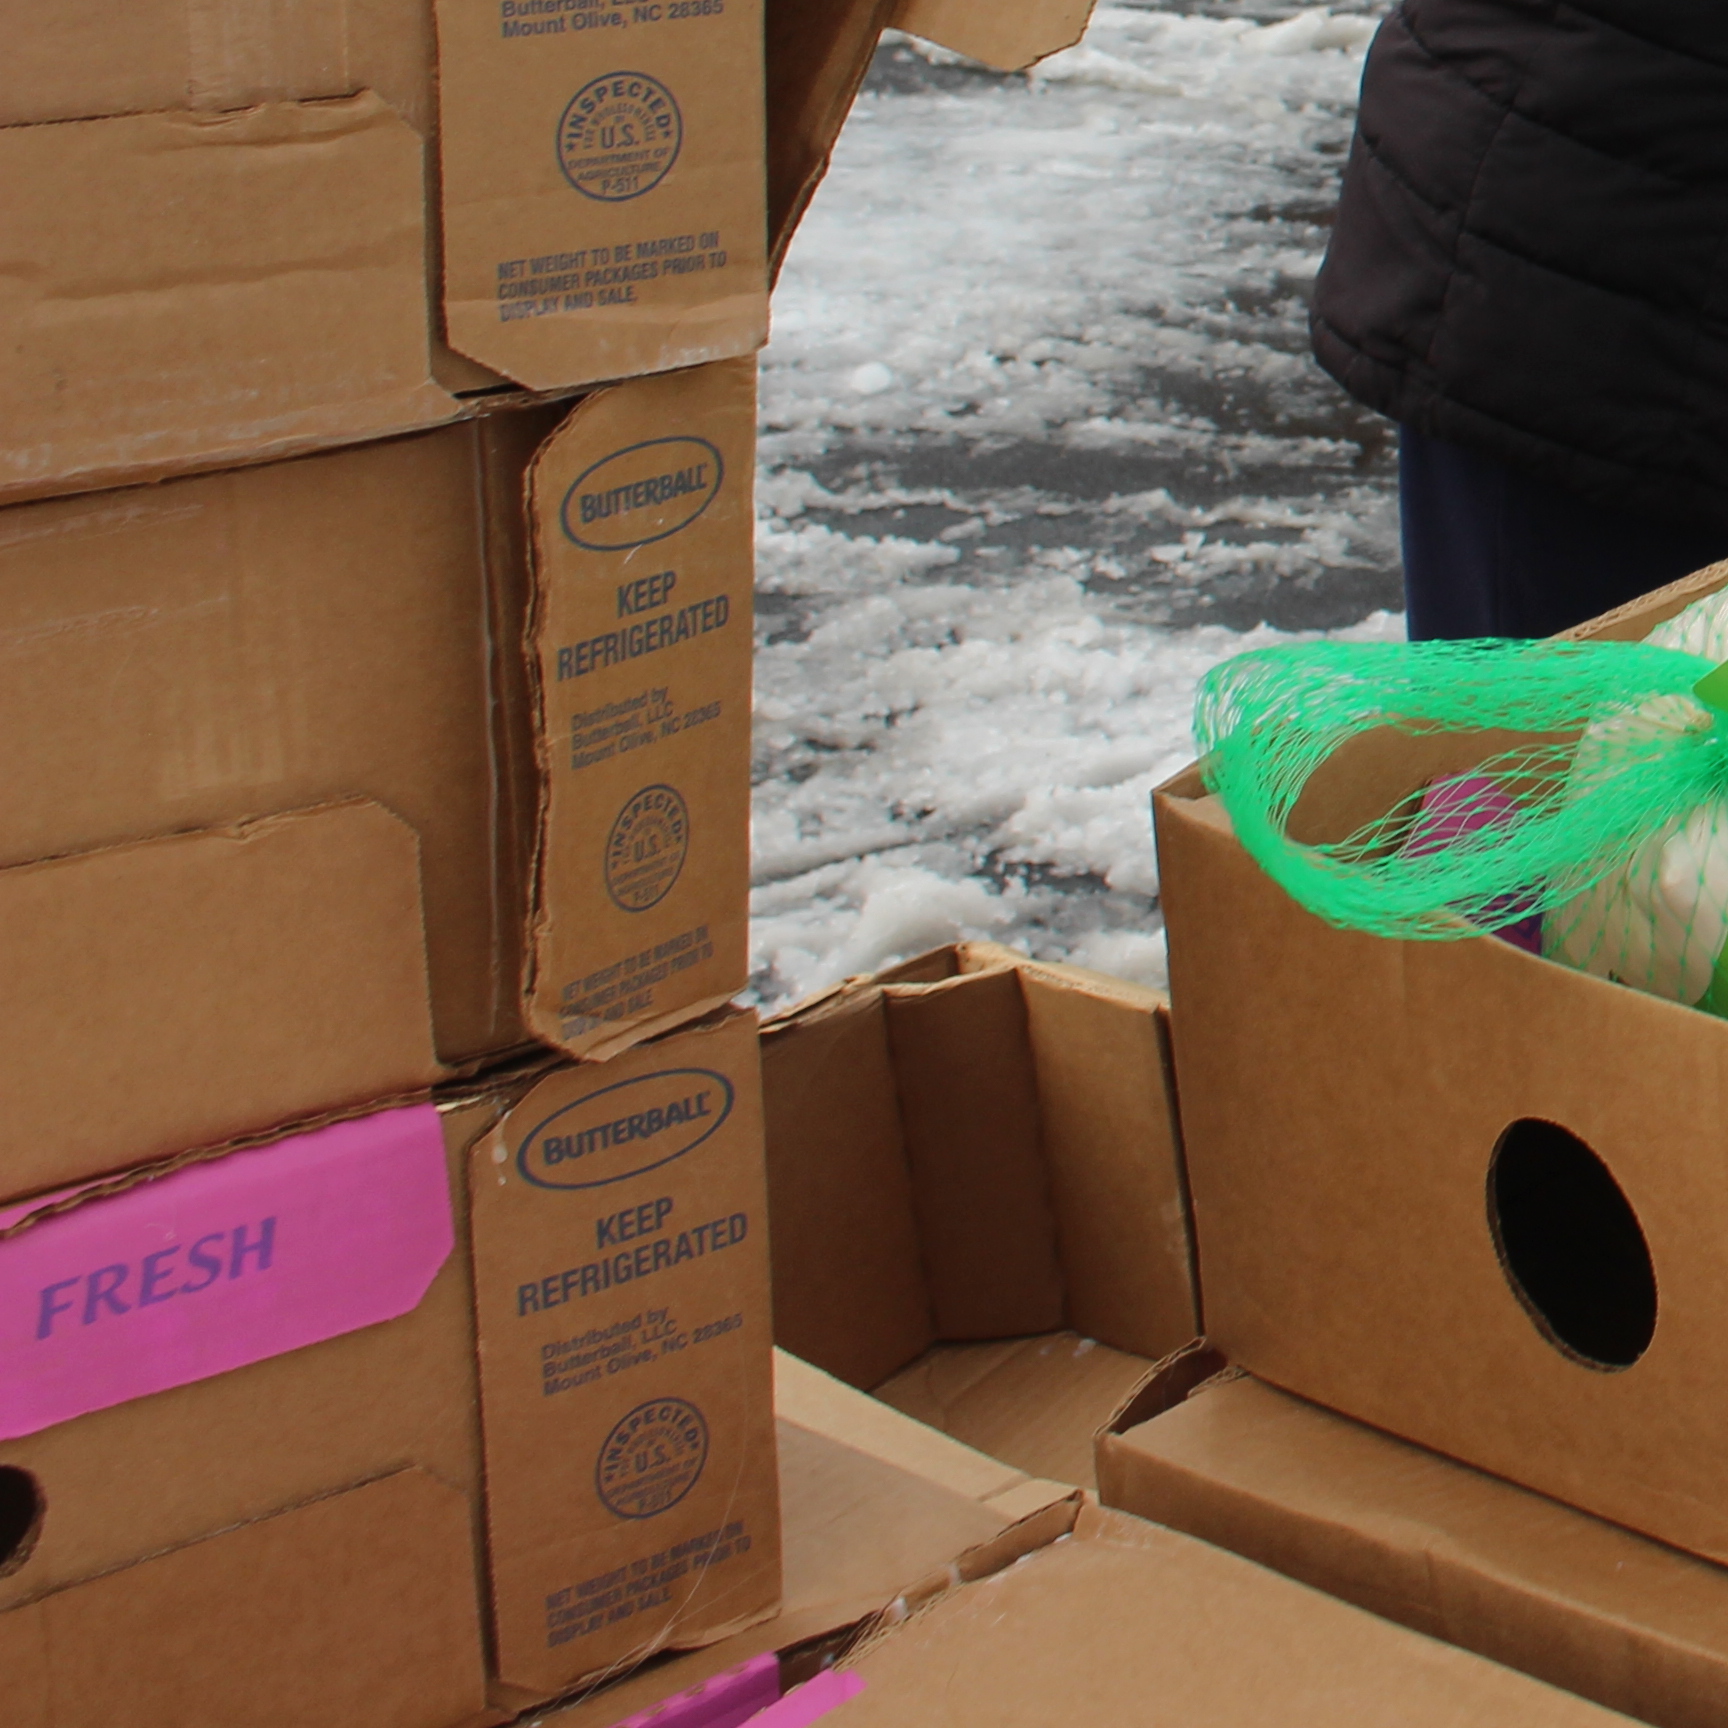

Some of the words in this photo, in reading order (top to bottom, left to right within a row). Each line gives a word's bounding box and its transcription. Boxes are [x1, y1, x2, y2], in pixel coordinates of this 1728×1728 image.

[502, 17, 566, 38] Mount
[571, 11, 628, 31] Olive,
[633, 4, 662, 23] NC
[566, 80, 671, 139] INSPECTED
[601, 123, 640, 149] U.S.
[498, 259, 526, 279] NET
[530, 251, 587, 273] WEIGHT
[591, 248, 610, 265] TO
[614, 244, 632, 263] BE
[636, 235, 695, 258] MARKED
[700, 231, 719, 249] ON
[498, 274, 580, 300] CONSUMER
[585, 260, 658, 286] PACKAGES
[663, 255, 705, 275] PRIOR
[708, 251, 727, 268] TO
[499, 297, 559, 322] DISPLAY
[564, 292, 593, 311] AND
[580, 462, 708, 524] BUTTERBALL
[617, 570, 676, 618] KEEP
[557, 594, 730, 682] REFRIGERATED
[543, 1090, 712, 1165] BUTTERBALL
[596, 1196, 674, 1250] KEEP
[35, 1217, 277, 1340] FRESH
[517, 1212, 748, 1317] REFRIGERATED
[641, 1319, 678, 1344] LLC
